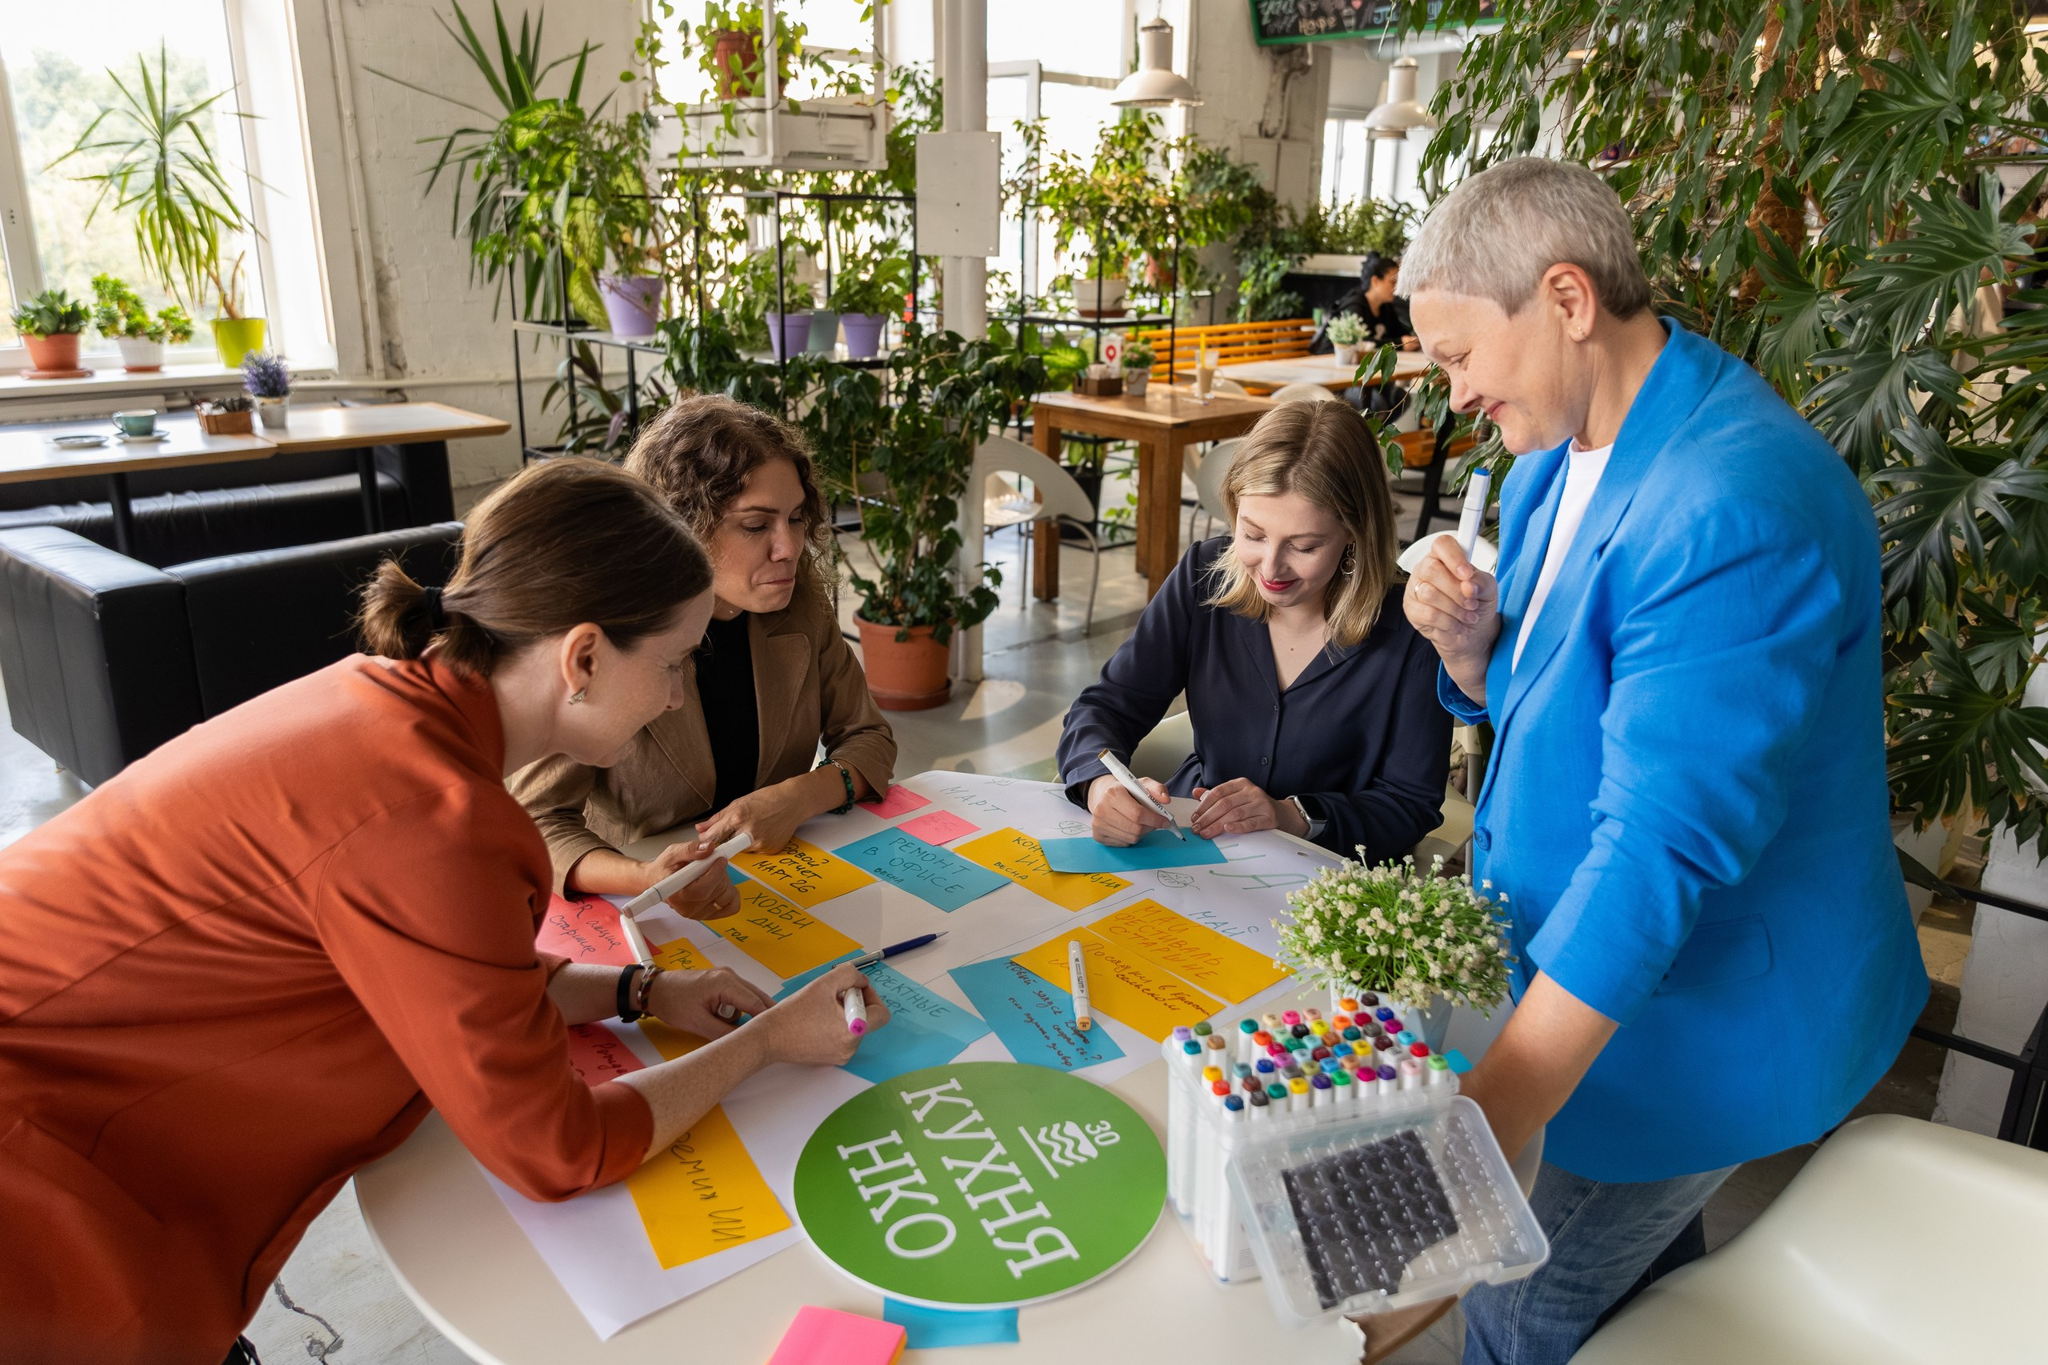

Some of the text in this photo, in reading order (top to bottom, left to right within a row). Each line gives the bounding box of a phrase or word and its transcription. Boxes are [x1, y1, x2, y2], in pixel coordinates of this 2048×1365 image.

[752, 860, 793, 881] МАРТ
[888, 837, 971, 875] РЕМОНТ
[888, 856, 965, 894] ОФИСЕ
[993, 861, 1030, 882] ВЕСНА
[744, 892, 815, 929] ХОББИ
[746, 917, 793, 940] ДНИ
[1109, 926, 1218, 979] СТАРШИЕ
[1114, 913, 1224, 966] ФЕСТИВАЛЬ
[837, 1130, 957, 1258] НКО
[900, 1078, 1080, 1279] КУХНЯ
